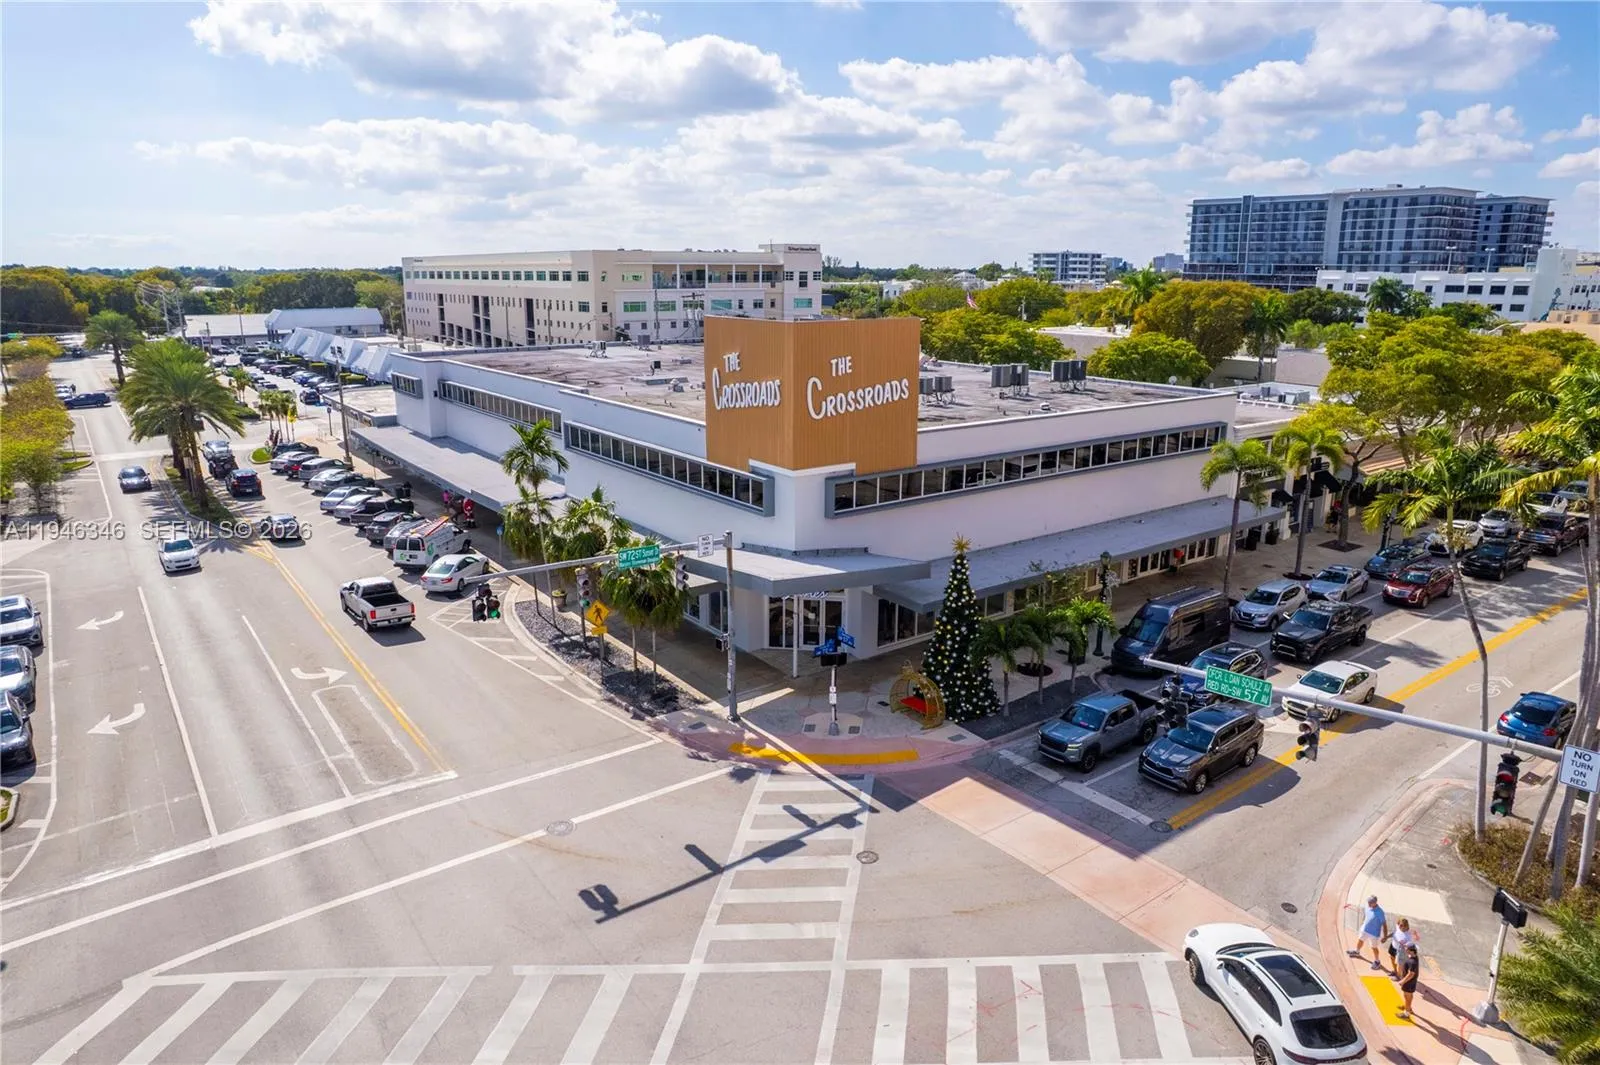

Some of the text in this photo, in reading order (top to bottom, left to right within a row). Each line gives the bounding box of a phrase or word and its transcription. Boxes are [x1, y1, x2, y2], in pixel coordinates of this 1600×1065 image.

[722, 352, 741, 373] THE
[830, 356, 853, 377] THE
[712, 367, 781, 410] CROSSROADS
[807, 376, 909, 420] CROSSROADS
[627, 550, 635, 561] 72
[1207, 680, 1219, 691] RED
[1244, 689, 1258, 702] 57
[1574, 751, 1592, 762] NO
[1571, 760, 1593, 771] TURN
[1570, 777, 1587, 787] RED
[1573, 770, 1586, 778] ON
